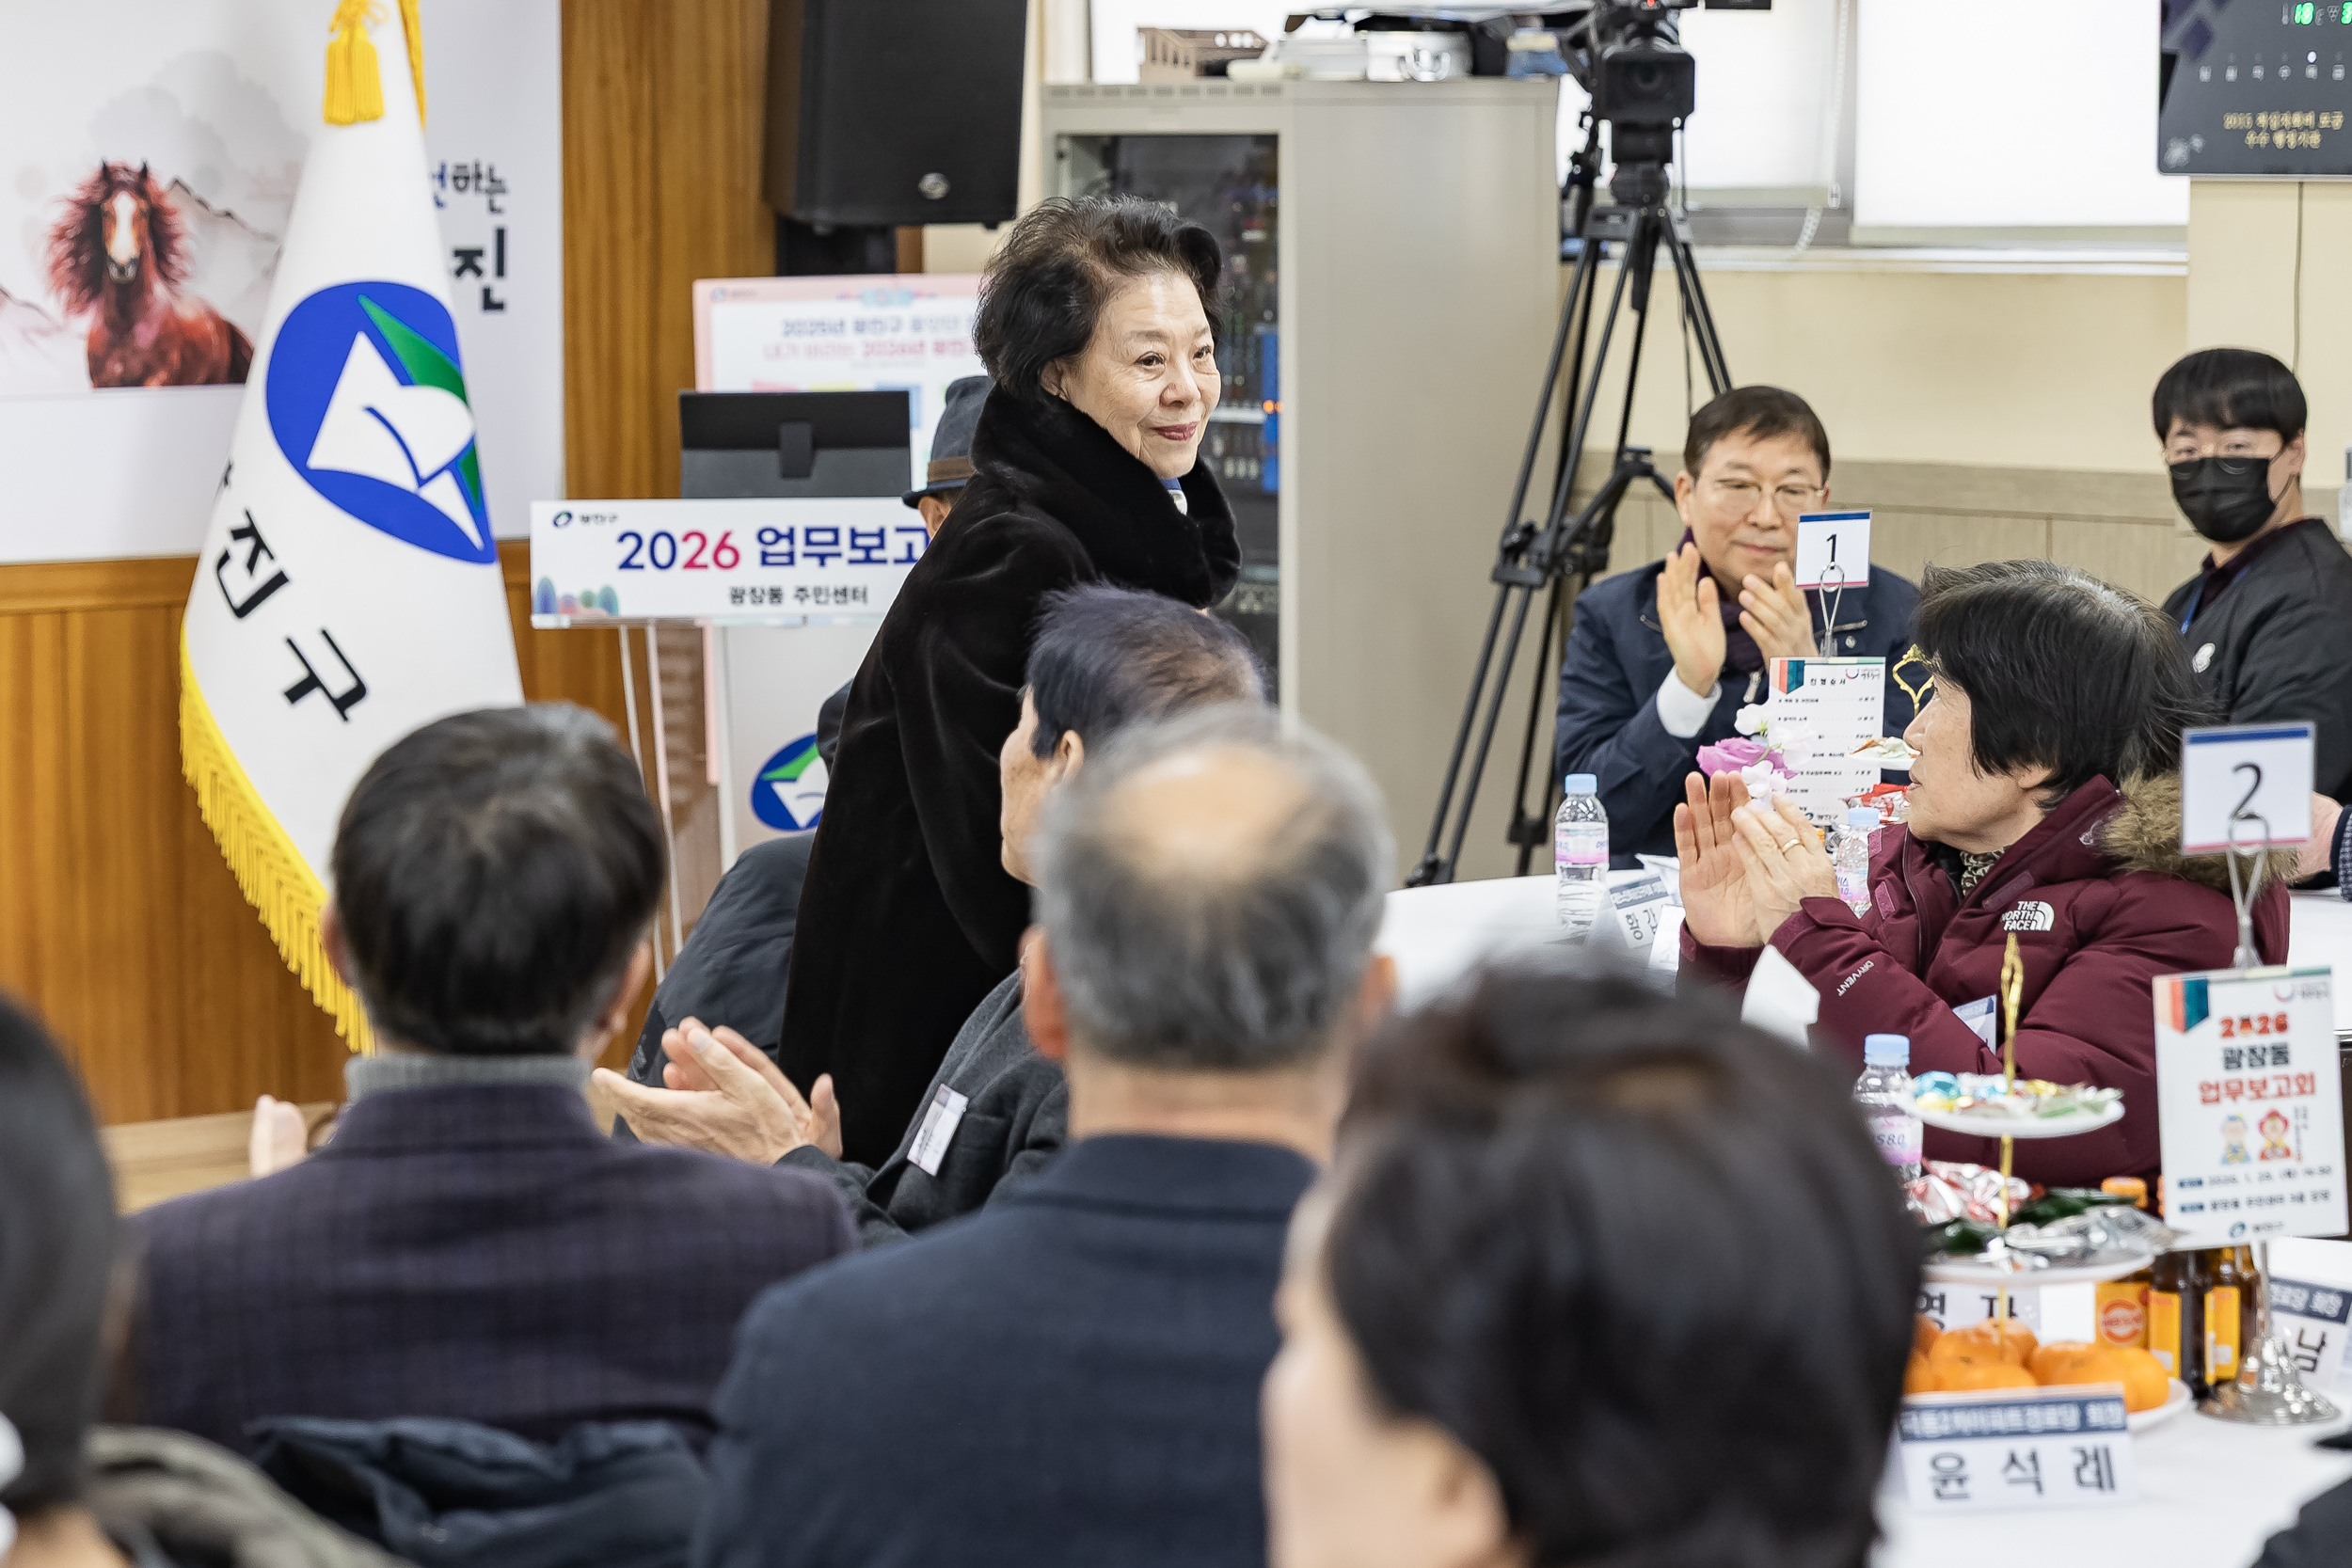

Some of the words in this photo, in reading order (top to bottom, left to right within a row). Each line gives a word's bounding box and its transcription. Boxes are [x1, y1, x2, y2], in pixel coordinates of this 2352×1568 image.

[453, 227, 505, 311] 진
[616, 530, 741, 571] 2026
[756, 525, 928, 568] 업무보고
[1826, 533, 1837, 570] 1
[215, 460, 368, 723] 진구
[729, 585, 785, 606] 광장동
[793, 584, 869, 606] 주민센터
[2230, 762, 2262, 820] 2
[2000, 910, 2036, 922] NORTH
[2017, 900, 2039, 911] THE
[2004, 919, 2032, 931] FACE
[1836, 959, 1875, 997] DRYVENT
[2222, 1042, 2290, 1070] 광장동
[2199, 1072, 2316, 1105] 업무보고회
